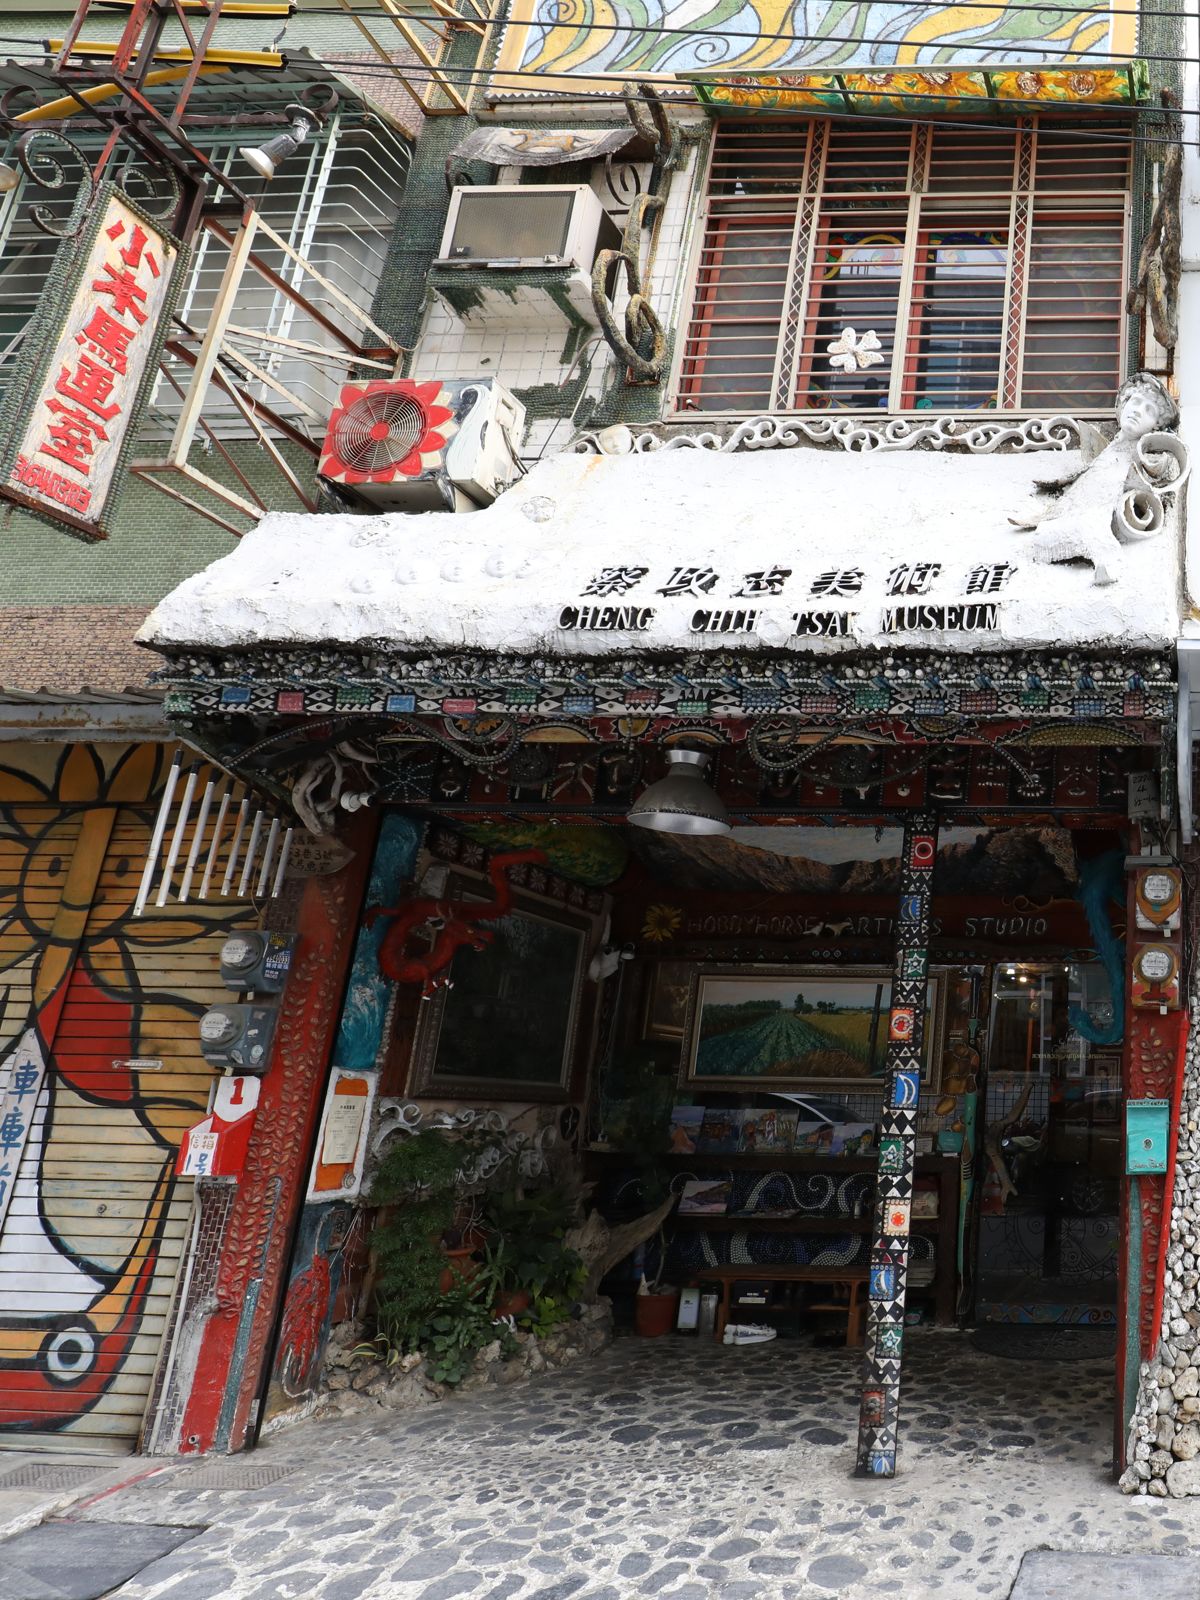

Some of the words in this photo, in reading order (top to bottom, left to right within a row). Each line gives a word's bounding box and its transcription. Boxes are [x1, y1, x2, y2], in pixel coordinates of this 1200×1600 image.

[558, 605, 657, 631] CHENG
[689, 608, 762, 633] CHIH
[790, 611, 858, 636] TSAI
[879, 603, 1002, 633] MUSEUM
[230, 1078, 244, 1105] 1
